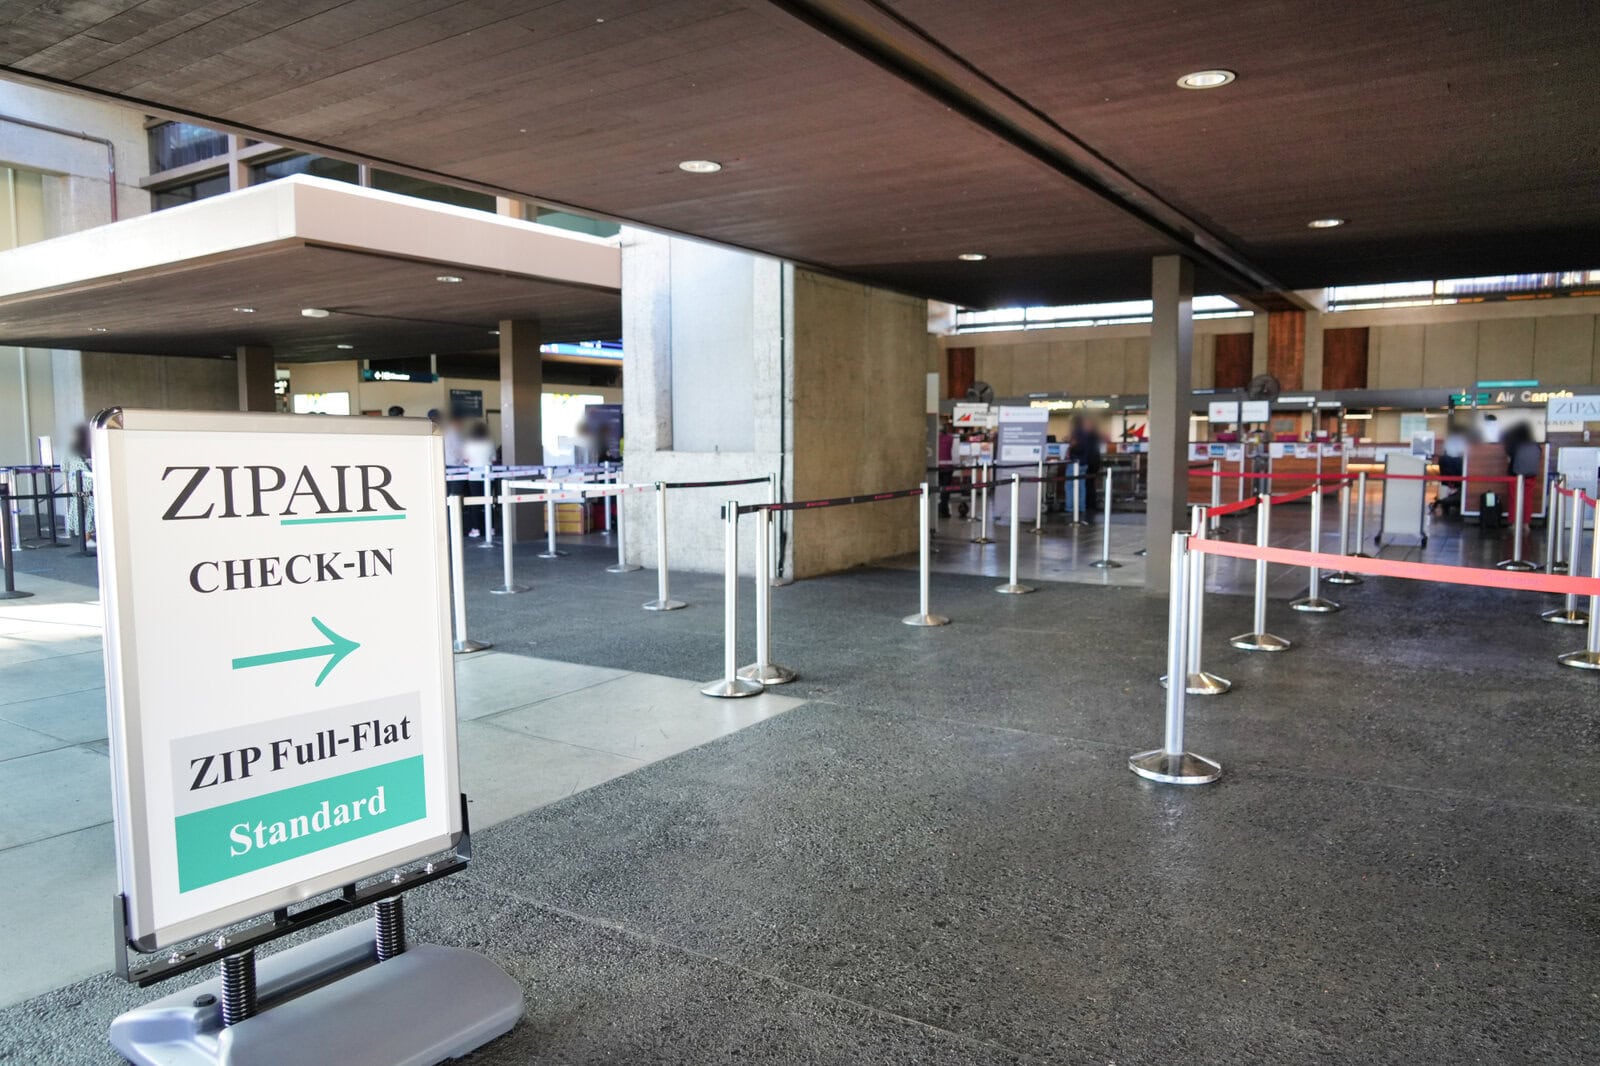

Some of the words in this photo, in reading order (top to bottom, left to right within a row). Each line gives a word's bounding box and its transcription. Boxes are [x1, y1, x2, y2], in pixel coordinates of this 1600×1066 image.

[1497, 391, 1515, 403] Air
[162, 465, 406, 521] ZIPAIR
[189, 548, 394, 594] CHECK-IN
[190, 747, 262, 791] ZIP
[270, 715, 411, 772] Full-Flat
[229, 786, 387, 858] Standard
